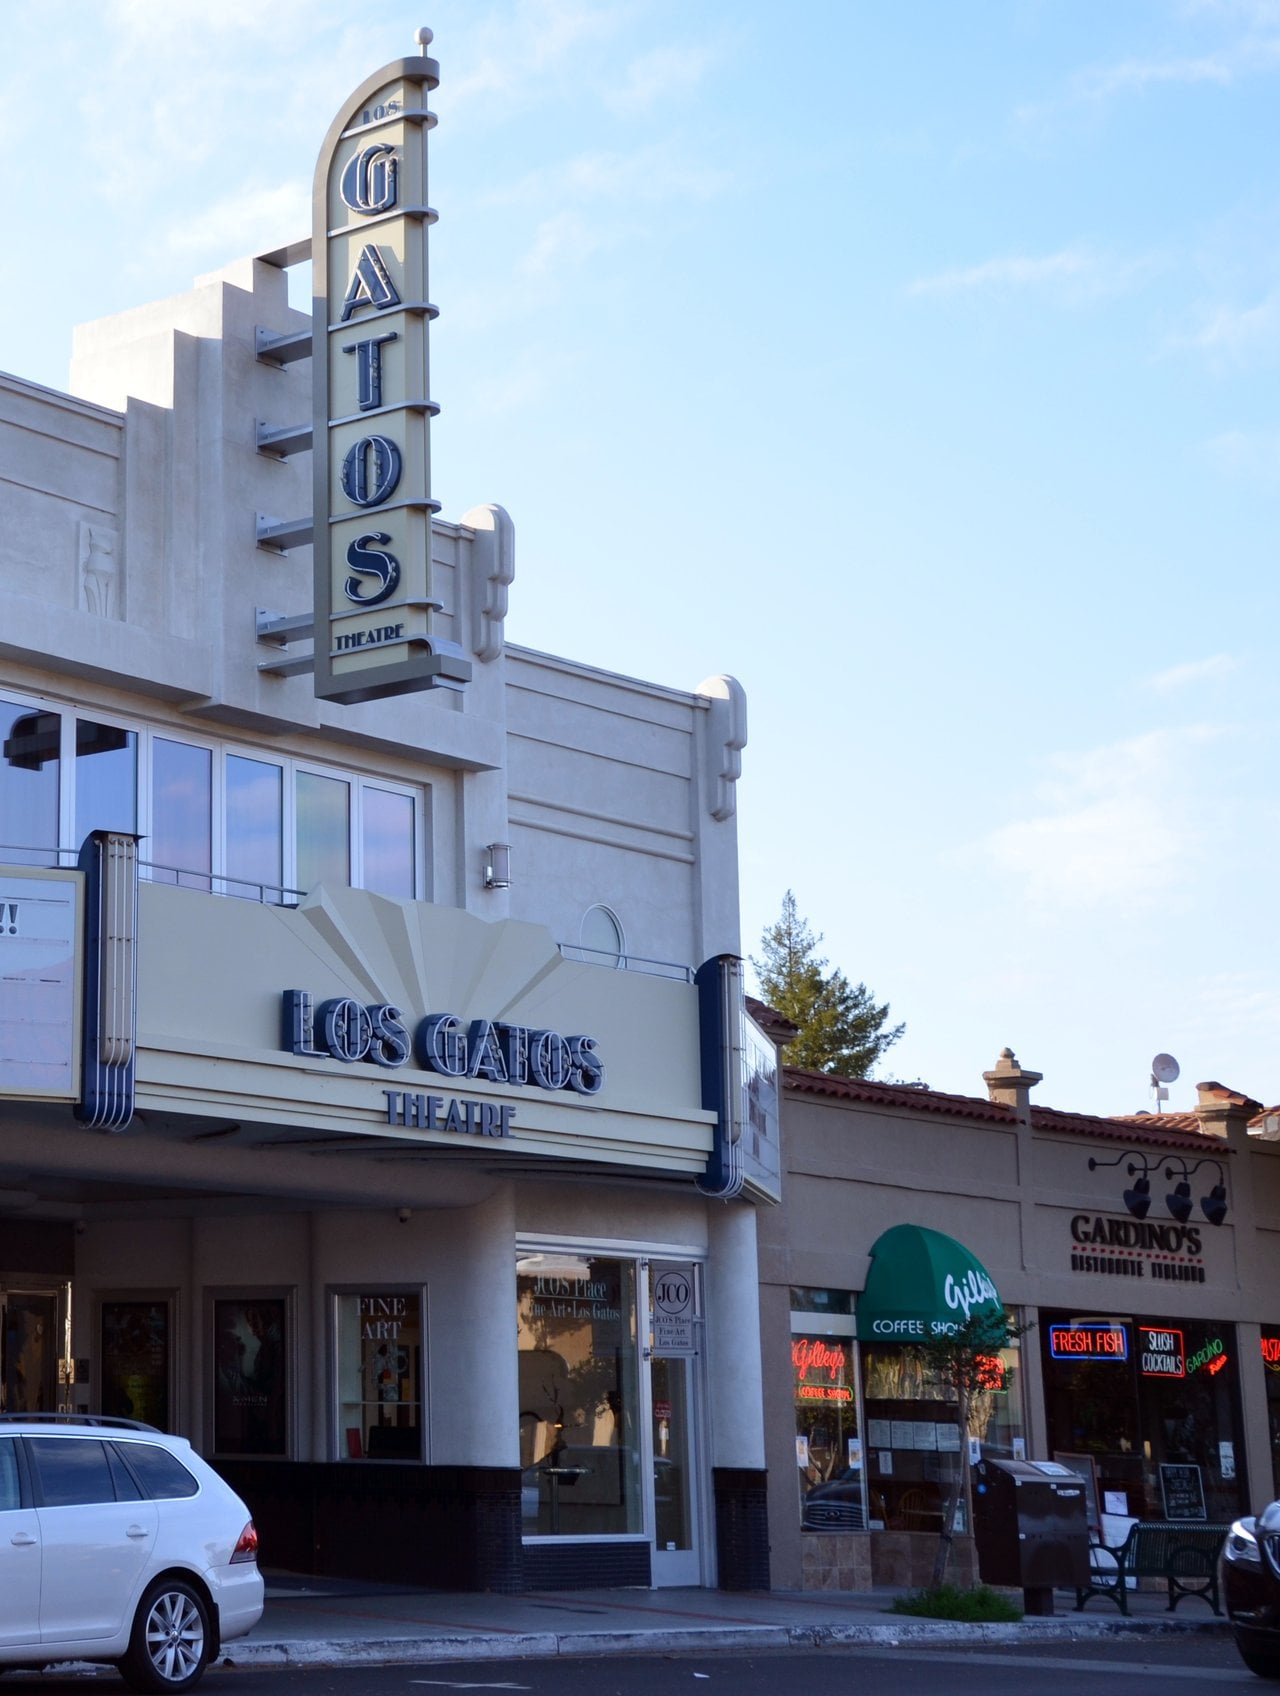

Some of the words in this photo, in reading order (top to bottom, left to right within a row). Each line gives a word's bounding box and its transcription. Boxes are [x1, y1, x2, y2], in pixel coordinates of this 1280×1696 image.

[362, 101, 400, 125] LOS
[339, 142, 402, 606] GATOS
[334, 623, 405, 650] THEATRE
[282, 989, 412, 1069] LOS
[414, 1012, 607, 1096] GATOS
[383, 1090, 517, 1139] THEATRE
[1070, 1215, 1202, 1256] GARDINO'S
[574, 1277, 607, 1298] Place
[657, 1283, 689, 1304] JCO
[353, 1297, 407, 1317] FINE
[573, 1300, 592, 1319] Los
[592, 1302, 621, 1321] Gatos
[362, 1321, 402, 1340] ART
[872, 1319, 924, 1334] COFFEE
[1051, 1331, 1093, 1352] FRESH
[1096, 1332, 1124, 1353] FISH
[1148, 1331, 1174, 1352] SLUSH
[794, 1339, 846, 1380] Gilley's
[1142, 1354, 1183, 1374] COCKTAILS
[801, 1386, 826, 1399] COFFEE
